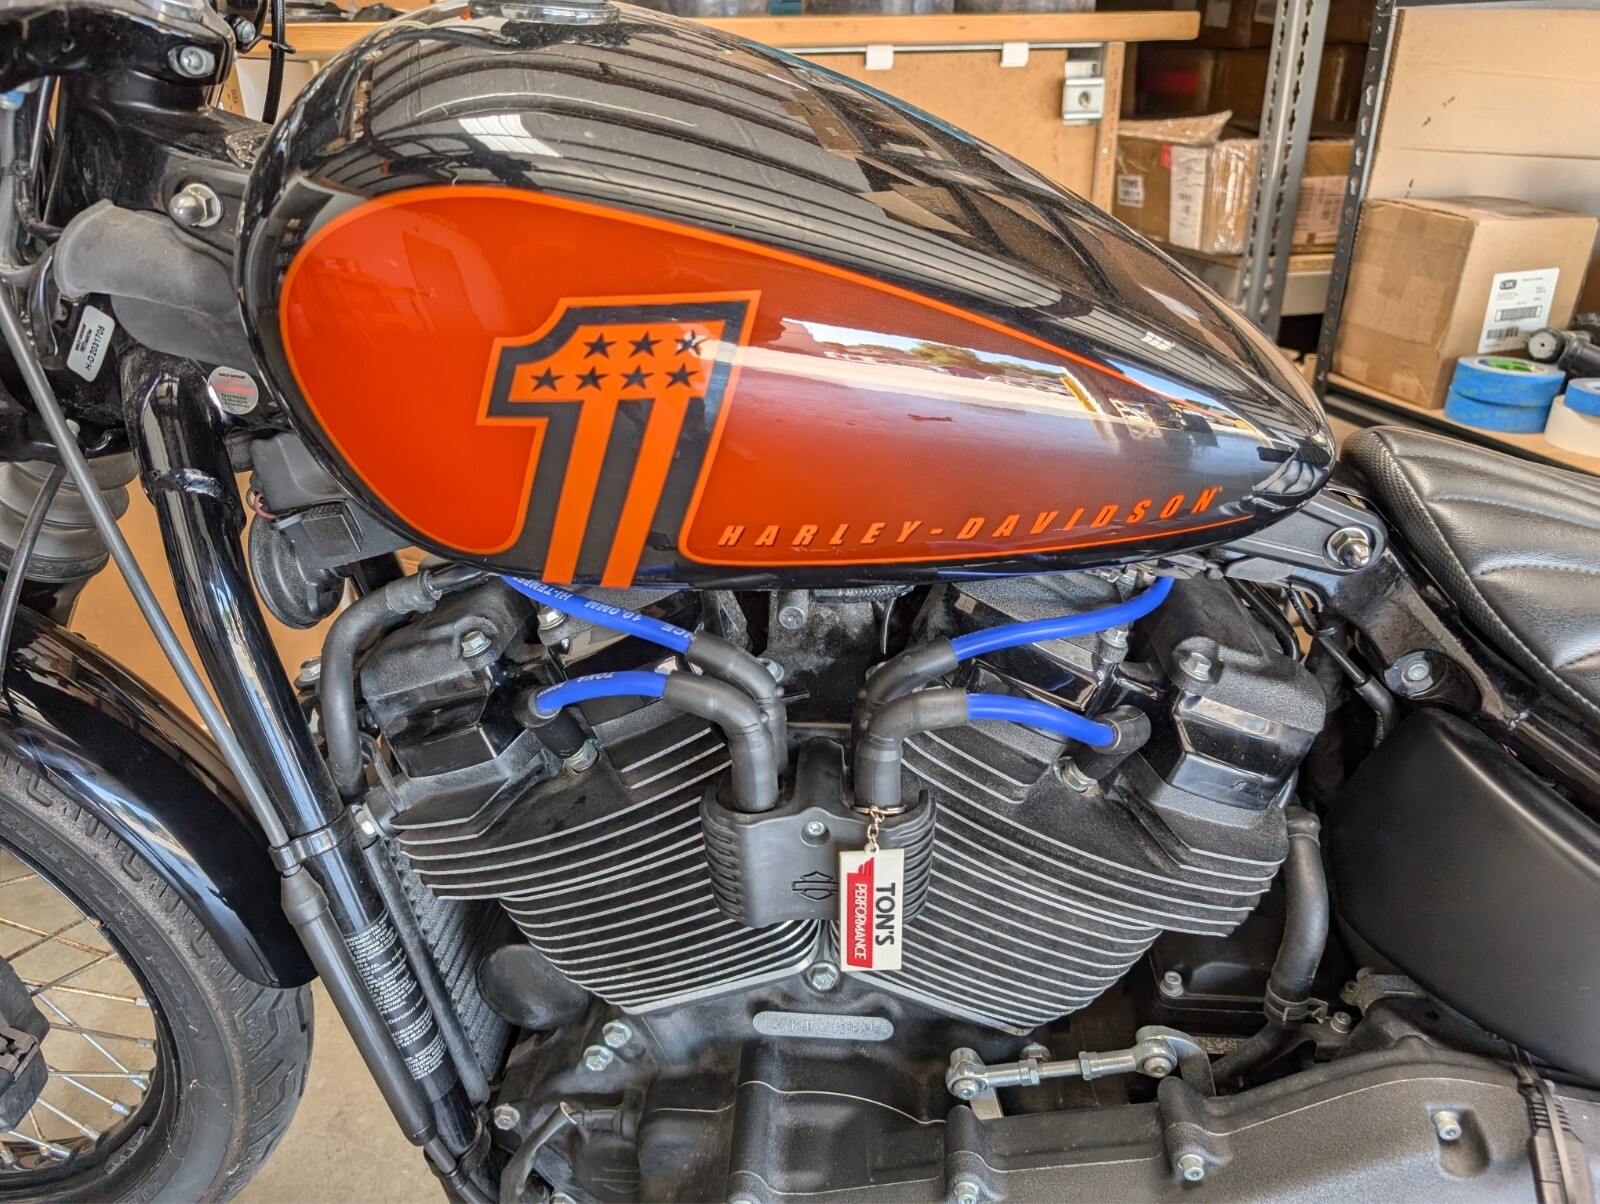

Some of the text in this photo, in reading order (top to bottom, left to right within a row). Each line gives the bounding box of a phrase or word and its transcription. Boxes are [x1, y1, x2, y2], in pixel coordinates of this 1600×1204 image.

[84, 355, 95, 371] H-D
[89, 325, 105, 357] 2031705
[717, 486, 1220, 547] HARLEY-DAVIDSON
[854, 882, 868, 960] PERFORMANCE
[875, 882, 896, 946] TON'S
